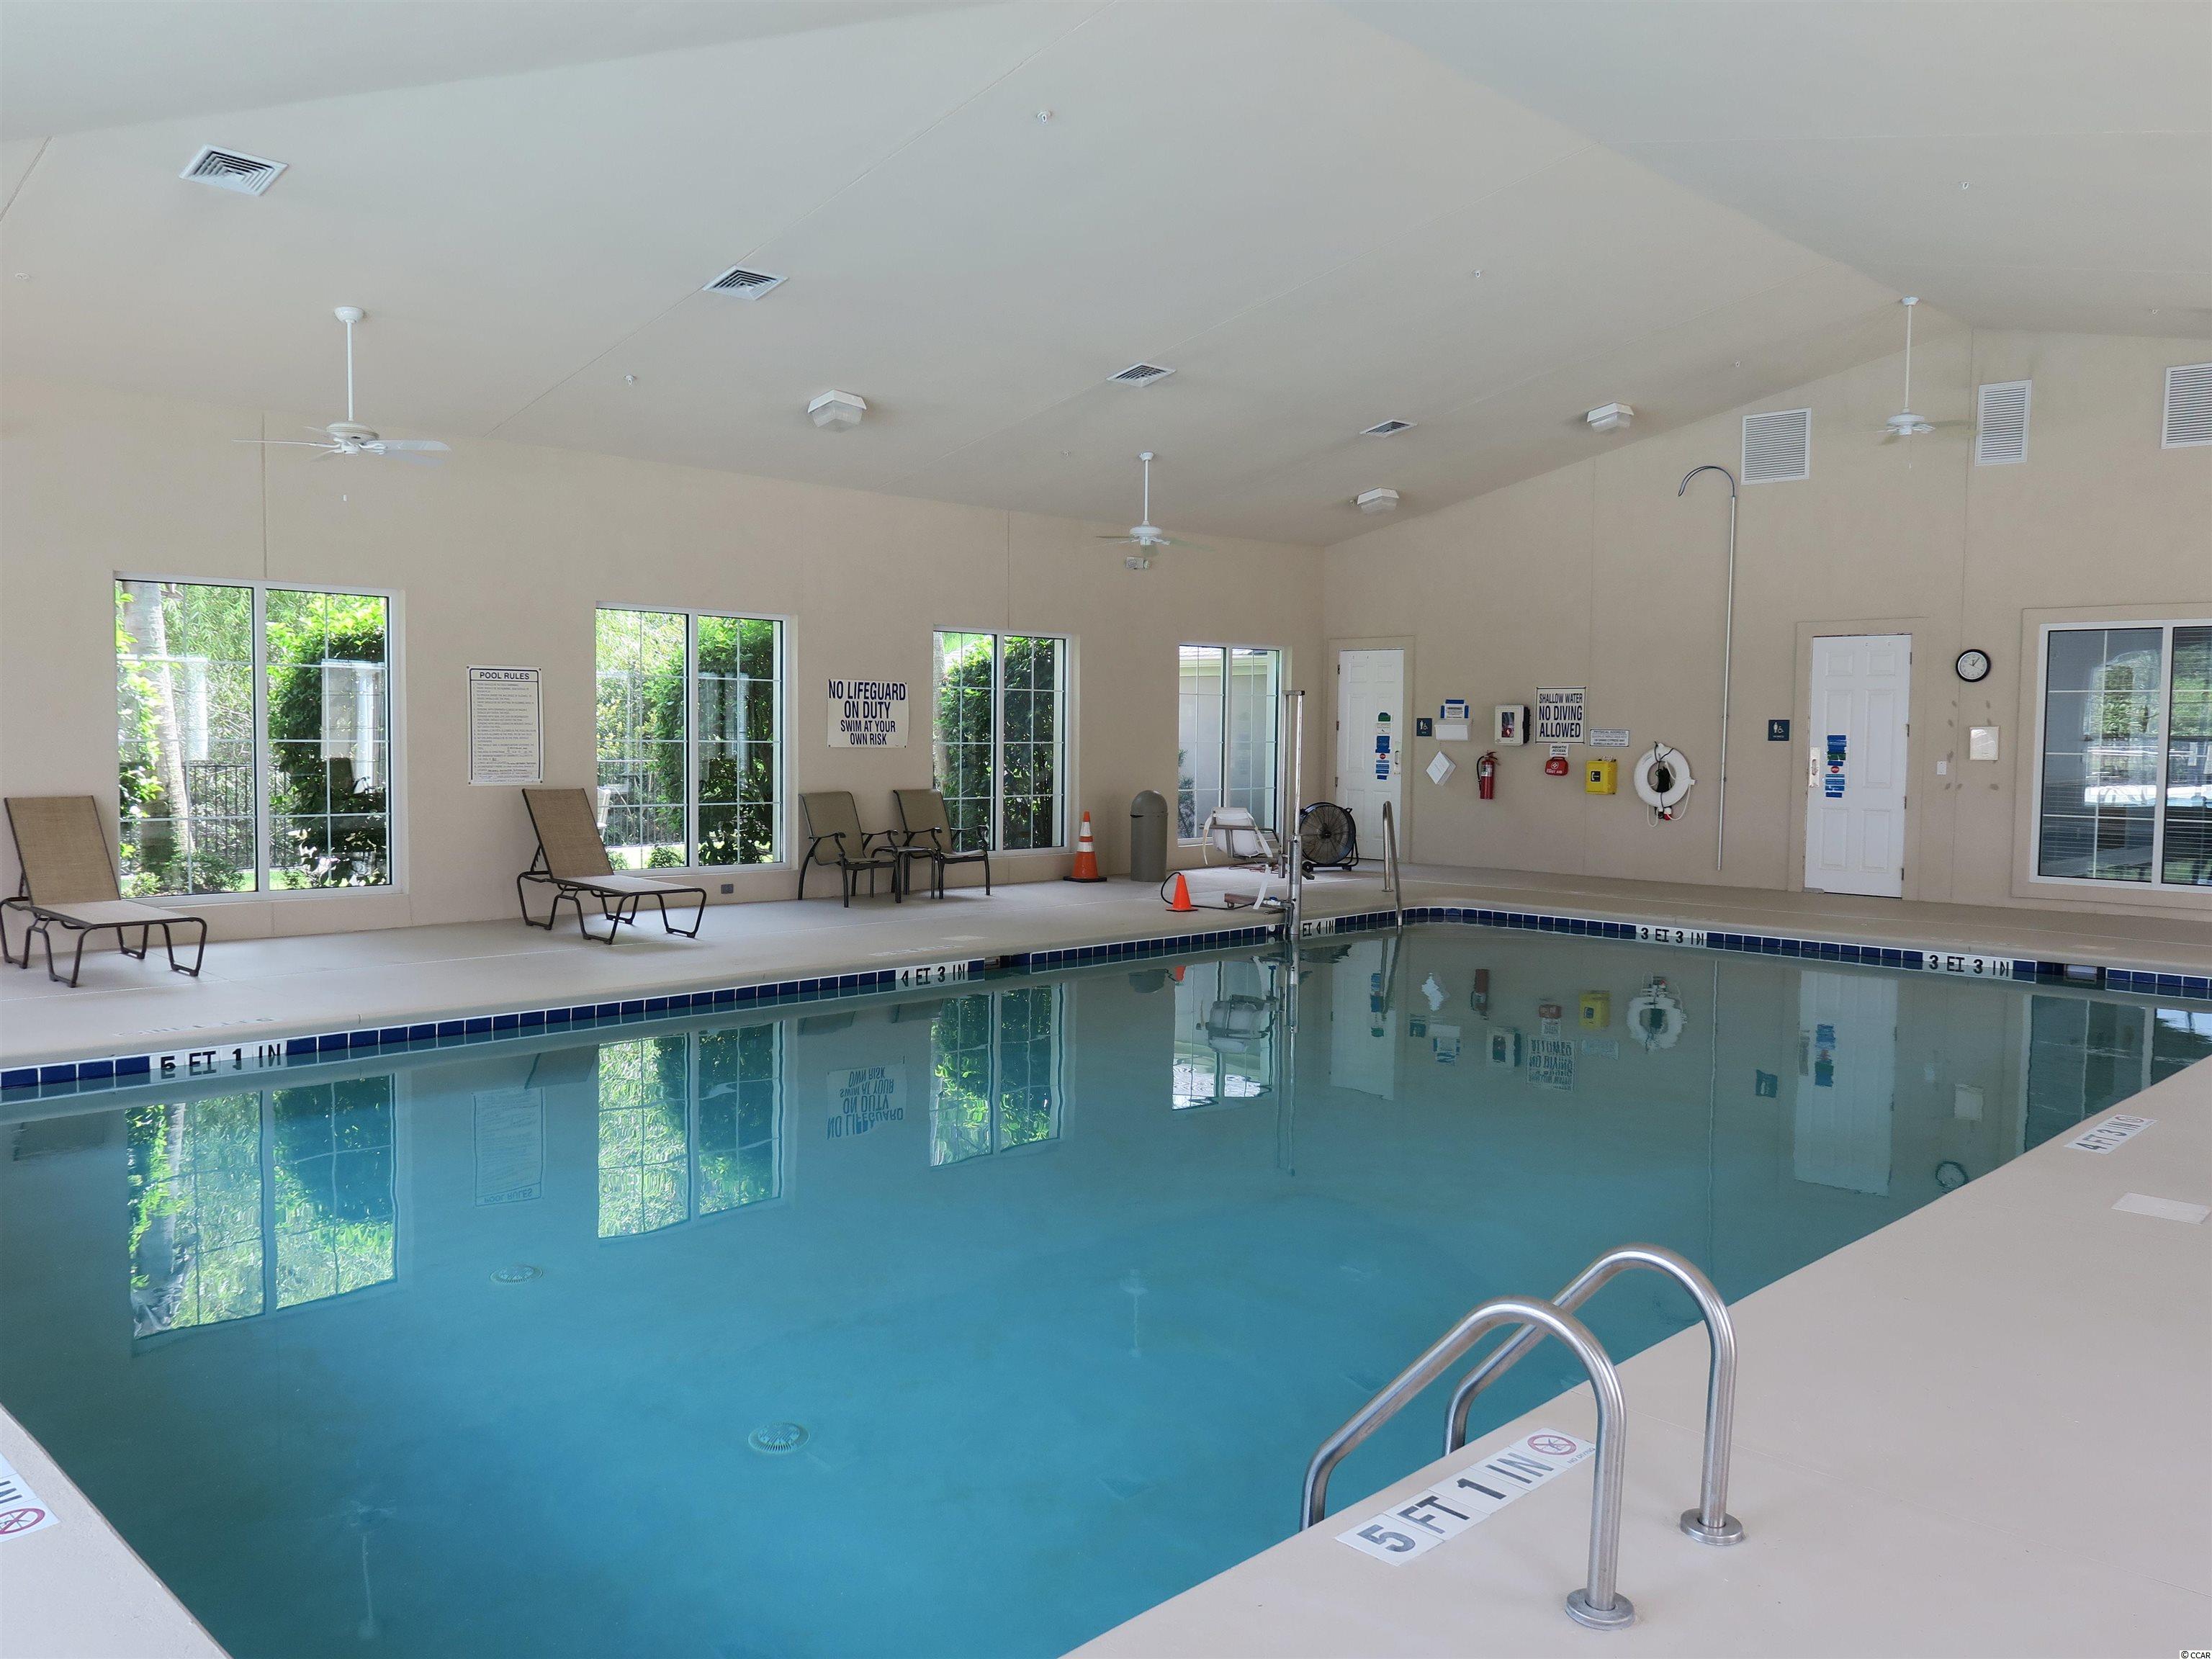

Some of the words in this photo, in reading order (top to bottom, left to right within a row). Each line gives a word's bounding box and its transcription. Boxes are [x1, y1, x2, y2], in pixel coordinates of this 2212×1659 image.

[829, 680, 844, 699] NO
[848, 681, 906, 701] LIFEGUARD
[1539, 693, 1563, 703] SHALLOW
[1565, 693, 1583, 703] WATER
[844, 700, 859, 719] ON
[863, 701, 891, 719] DUTY
[1539, 706, 1550, 721] NO
[1553, 706, 1583, 721] DIVING
[840, 719, 862, 732] SWIM
[863, 720, 873, 732] AT
[875, 720, 896, 732] YOUR
[1539, 722, 1581, 738] ALLOWED
[850, 733, 868, 745] OWN
[870, 733, 887, 745] RISK
[161, 1056, 176, 1070] 5
[232, 1048, 242, 1061] 1
[258, 1043, 281, 1058] IN
[2082, 1134, 2119, 1146] FT
[2105, 1121, 2141, 1132] IN
[1356, 1524, 1416, 1552] 5
[1397, 1495, 1470, 1534] FT
[1456, 1478, 1507, 1500] 1
[1485, 1452, 1555, 1485] IN
